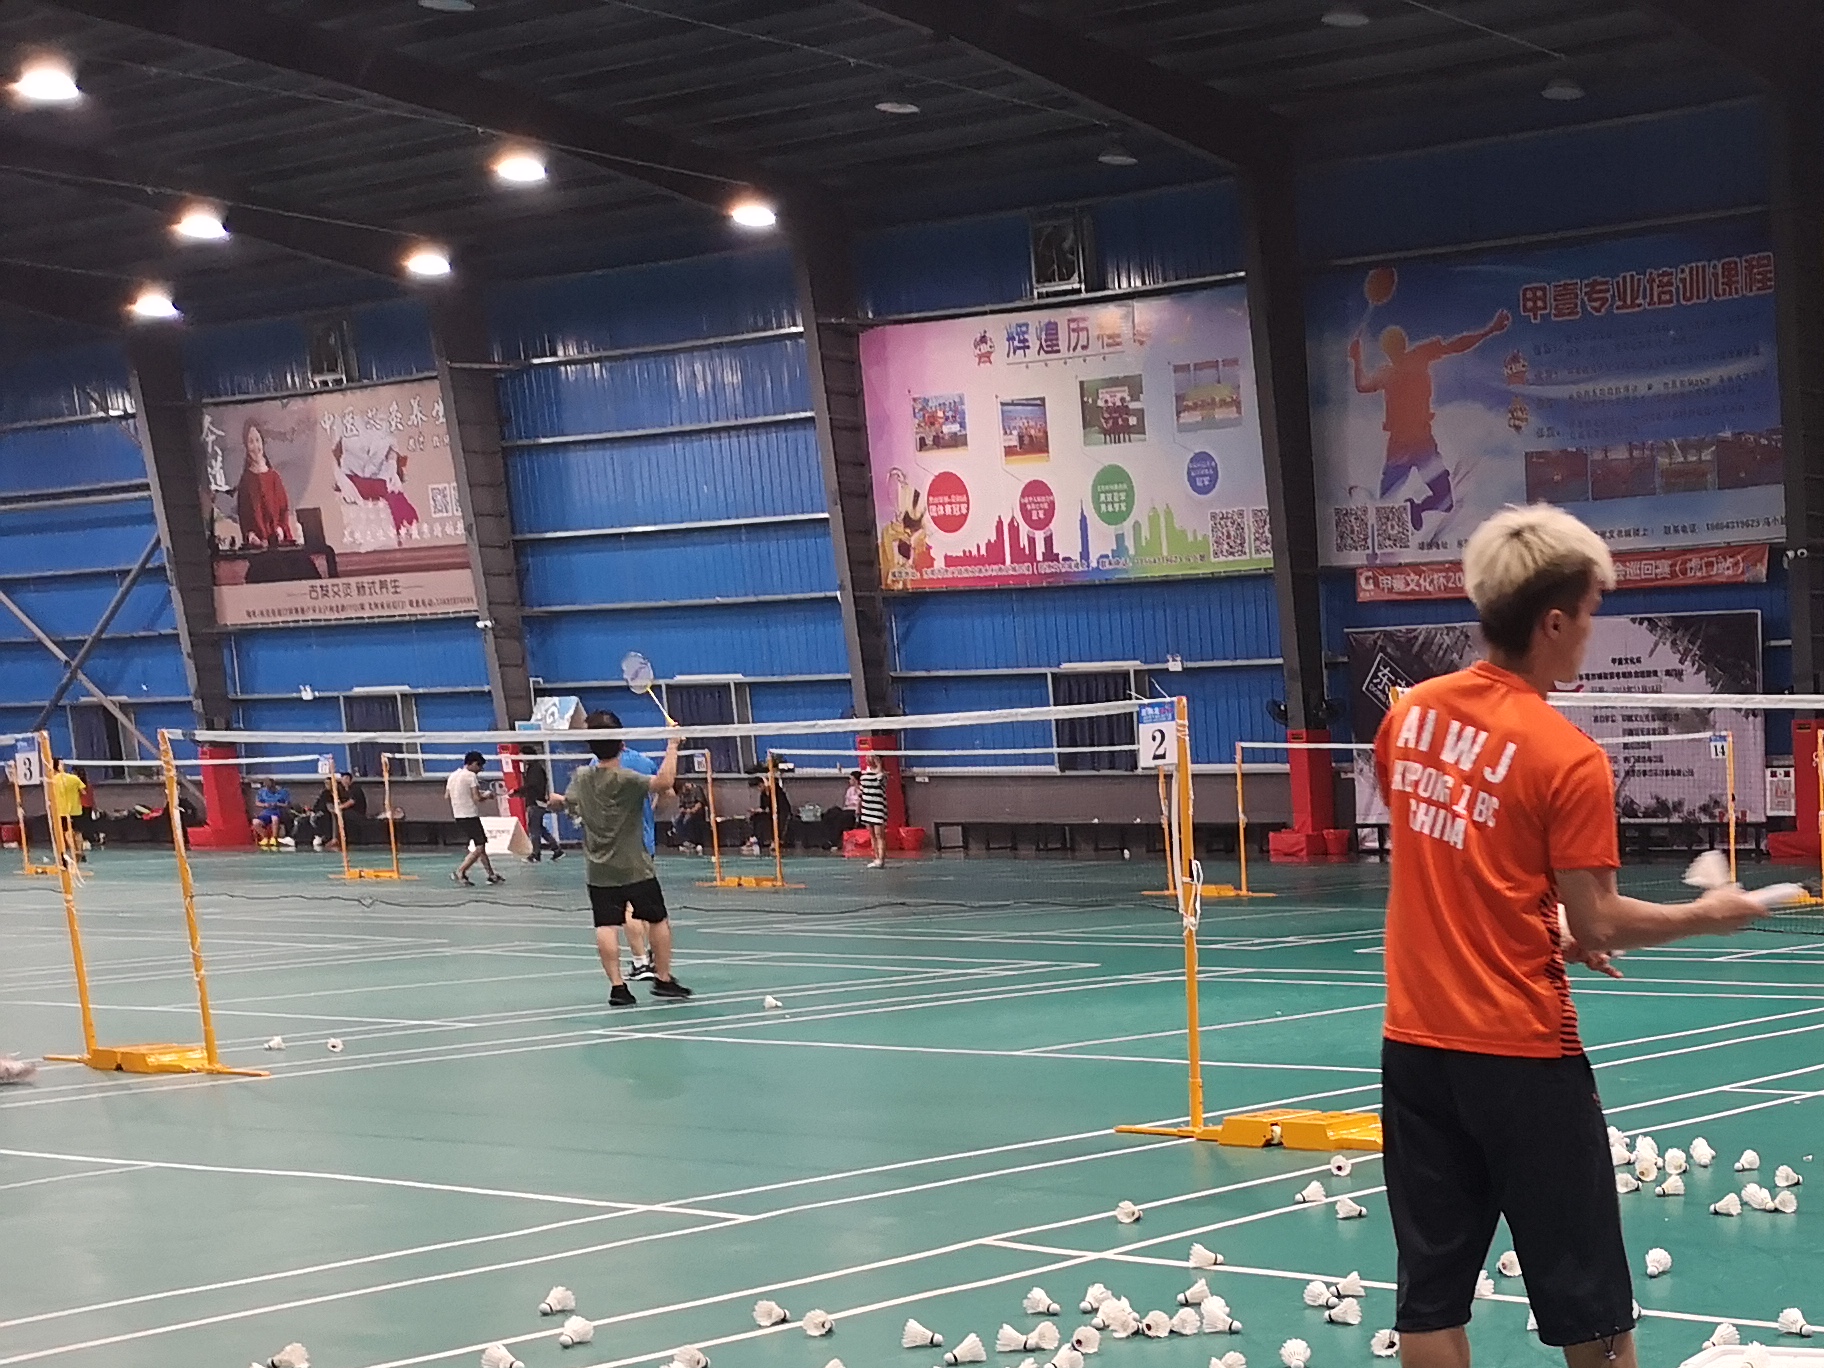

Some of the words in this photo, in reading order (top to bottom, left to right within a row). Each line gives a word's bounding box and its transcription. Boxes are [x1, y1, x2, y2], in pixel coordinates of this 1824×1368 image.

[1520, 252, 1775, 323] 甲壹专业培训课程
[1151, 728, 1167, 761] 2
[1396, 705, 1438, 752] AI
[1439, 719, 1489, 772] W
[1483, 741, 1517, 784] J
[1714, 744, 1726, 757] 14
[23, 757, 33, 781] 3
